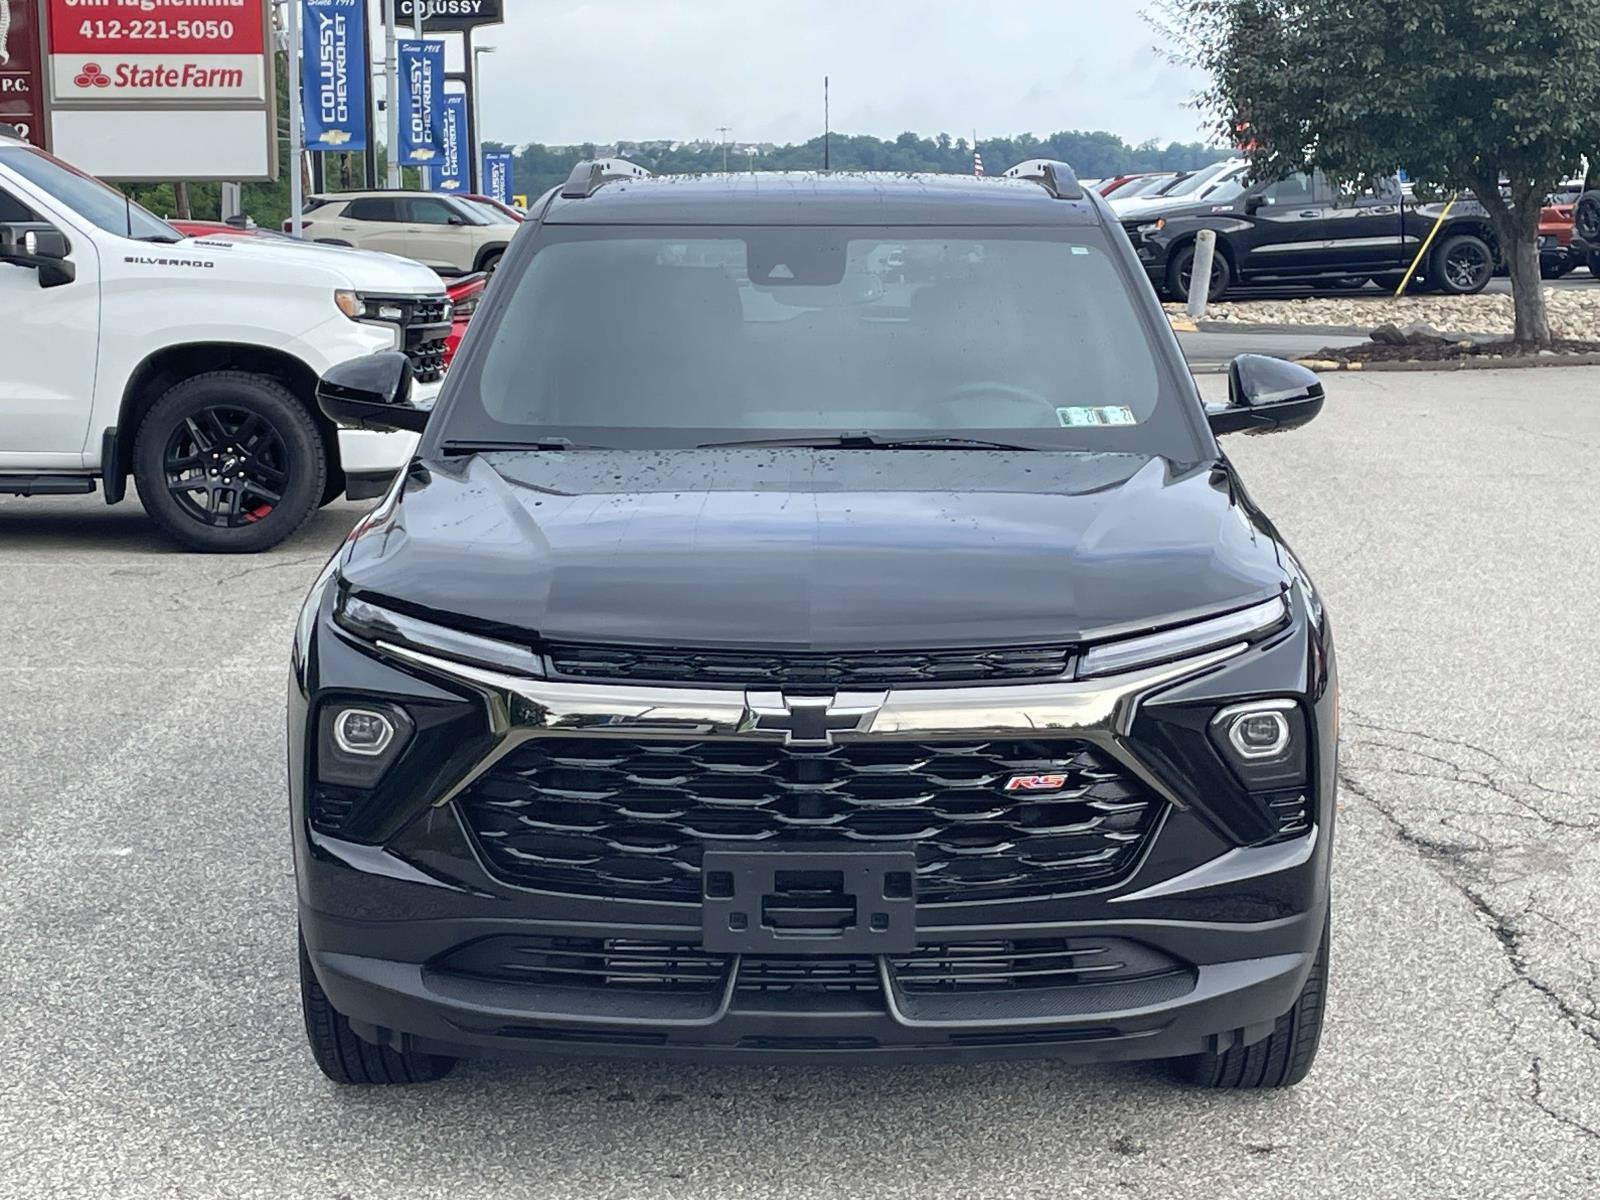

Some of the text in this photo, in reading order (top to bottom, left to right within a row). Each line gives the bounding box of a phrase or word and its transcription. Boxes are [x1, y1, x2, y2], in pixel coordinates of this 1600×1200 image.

[79, 20, 234, 39] 412-221-5050
[2, 78, 30, 92] P.C.
[319, 13, 336, 123] COLUSSY
[335, 13, 348, 122] CHEVROLET
[411, 57, 423, 144] COLUSSY
[422, 57, 433, 143] CHEVROLET
[448, 107, 459, 176] CHEVROLET
[124, 256, 214, 268] SILVERADO
[1004, 774, 1068, 790] RS
